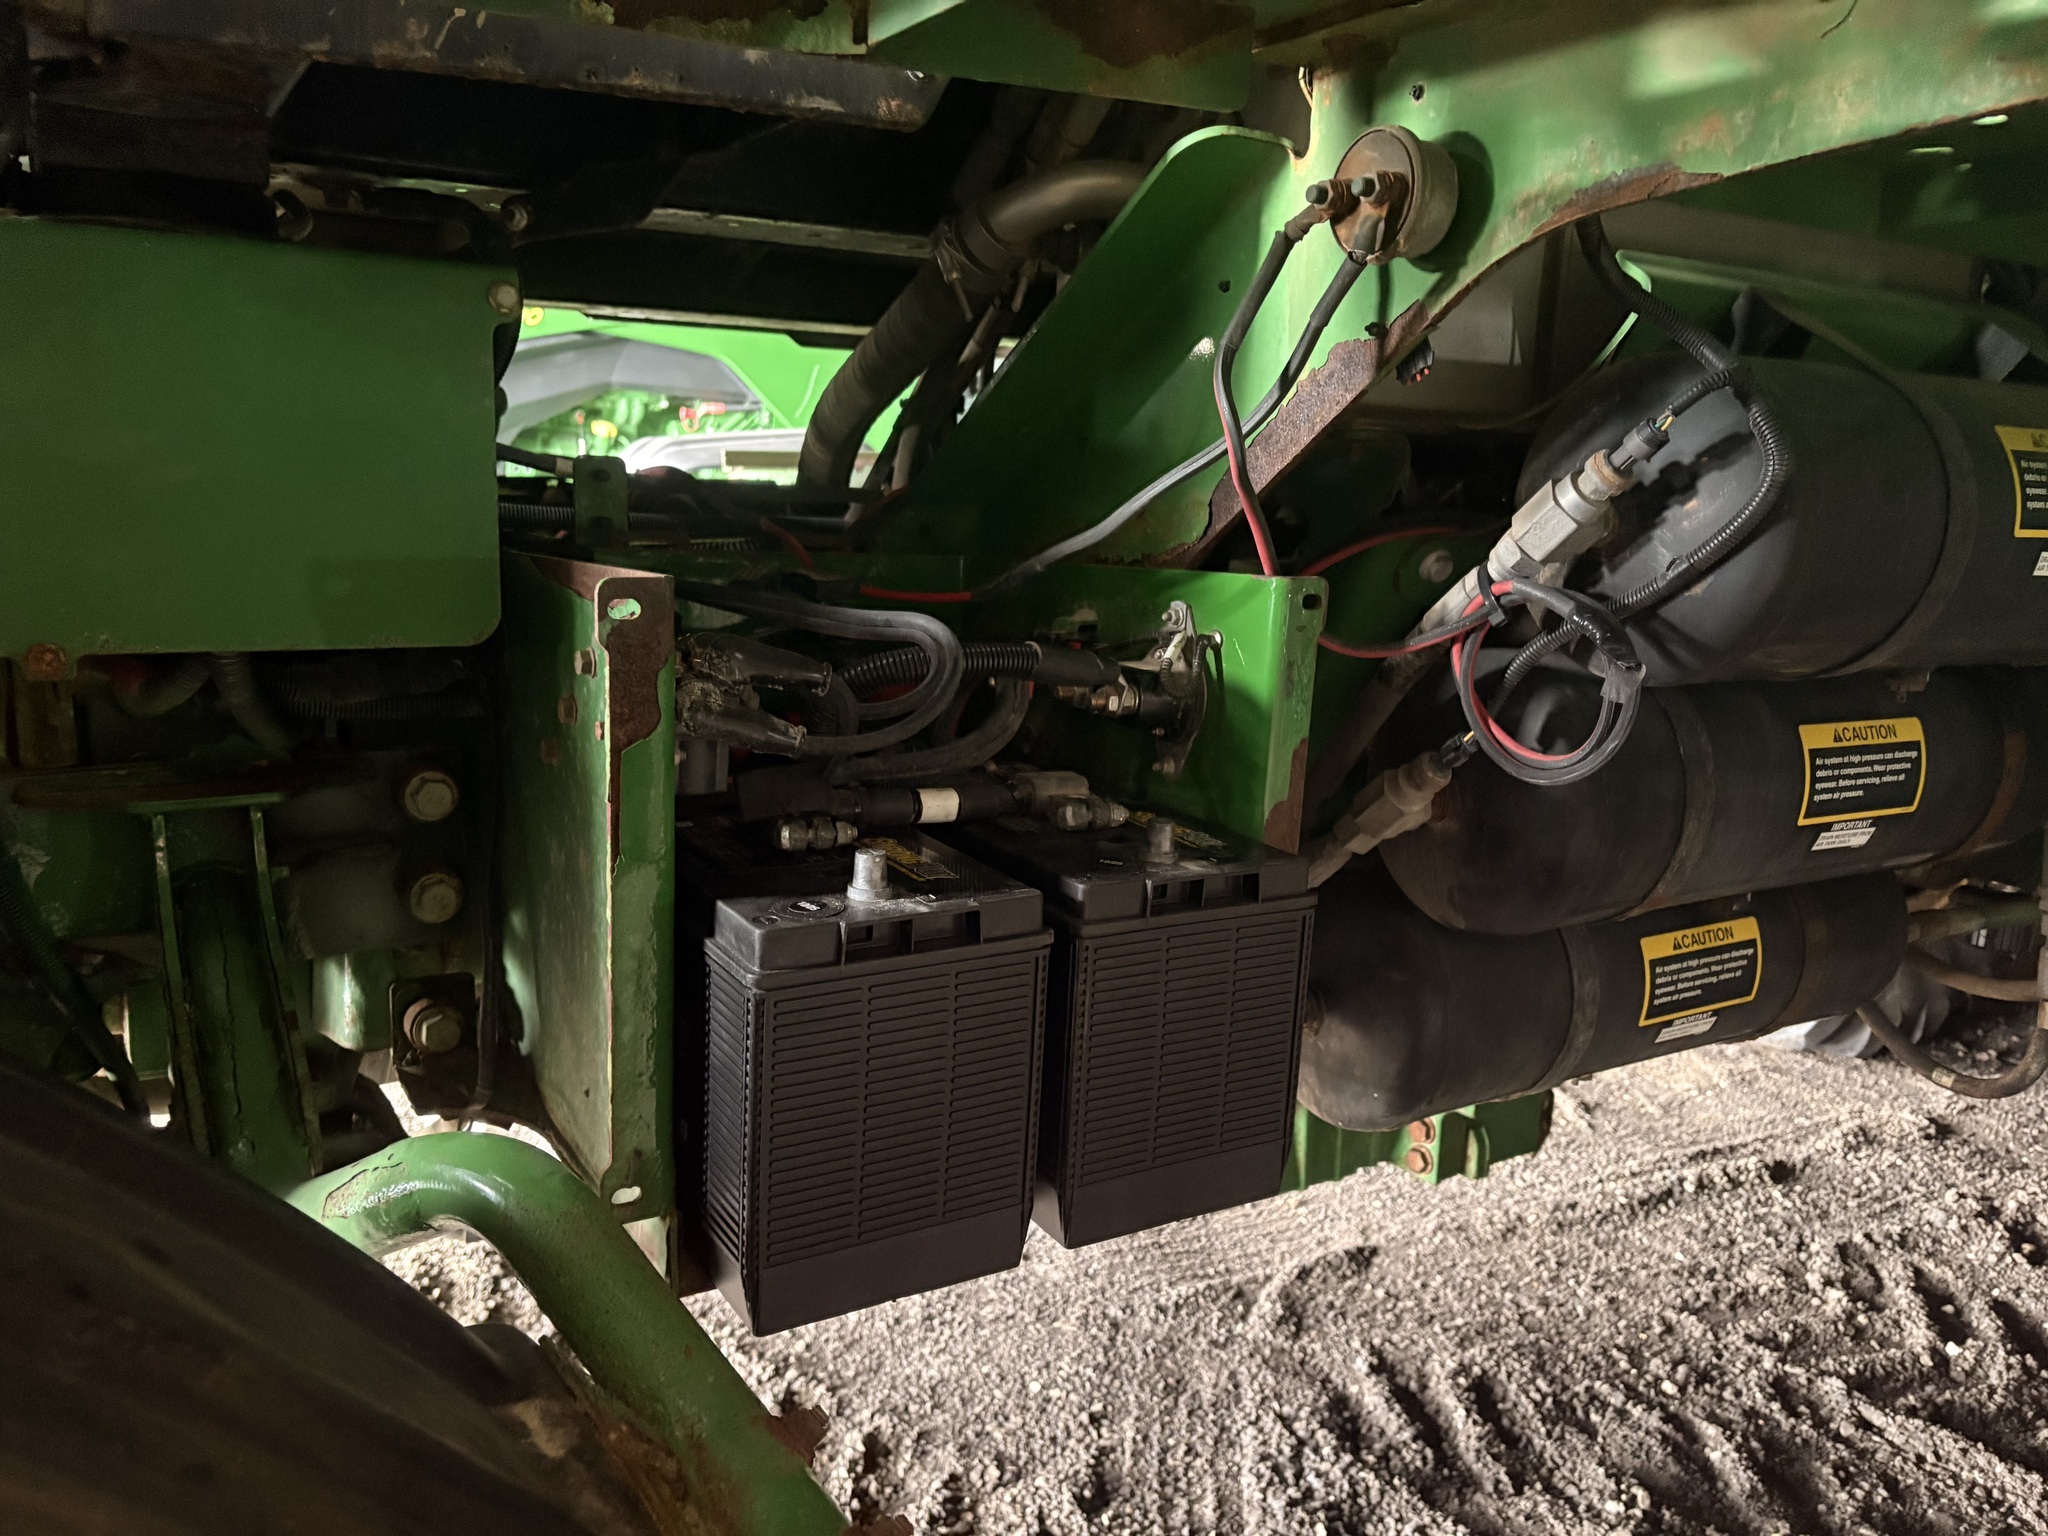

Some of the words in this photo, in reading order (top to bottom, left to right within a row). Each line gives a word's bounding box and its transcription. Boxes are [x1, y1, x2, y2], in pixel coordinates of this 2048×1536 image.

[1842, 724, 1897, 742] CAUTION
[1816, 757, 1824, 766] Air
[1824, 757, 1843, 766] system
[1850, 755, 1861, 764] high
[1862, 754, 1884, 763] pressure
[1894, 750, 1918, 759] discharge
[1816, 769, 1833, 778] debris
[1840, 766, 1873, 776] components.
[1873, 764, 1886, 772] Wear
[1887, 762, 1912, 772] protective
[1815, 782, 1838, 791] eyewear.
[1839, 779, 1856, 787] Before
[1856, 776, 1881, 785] servicing,
[1814, 793, 1833, 803] system
[1840, 790, 1864, 800] pressure.
[1831, 820, 1873, 831] IMPORTANT
[1681, 926, 1734, 949] CAUTION
[1672, 1011, 1713, 1027] IMPORTANT
